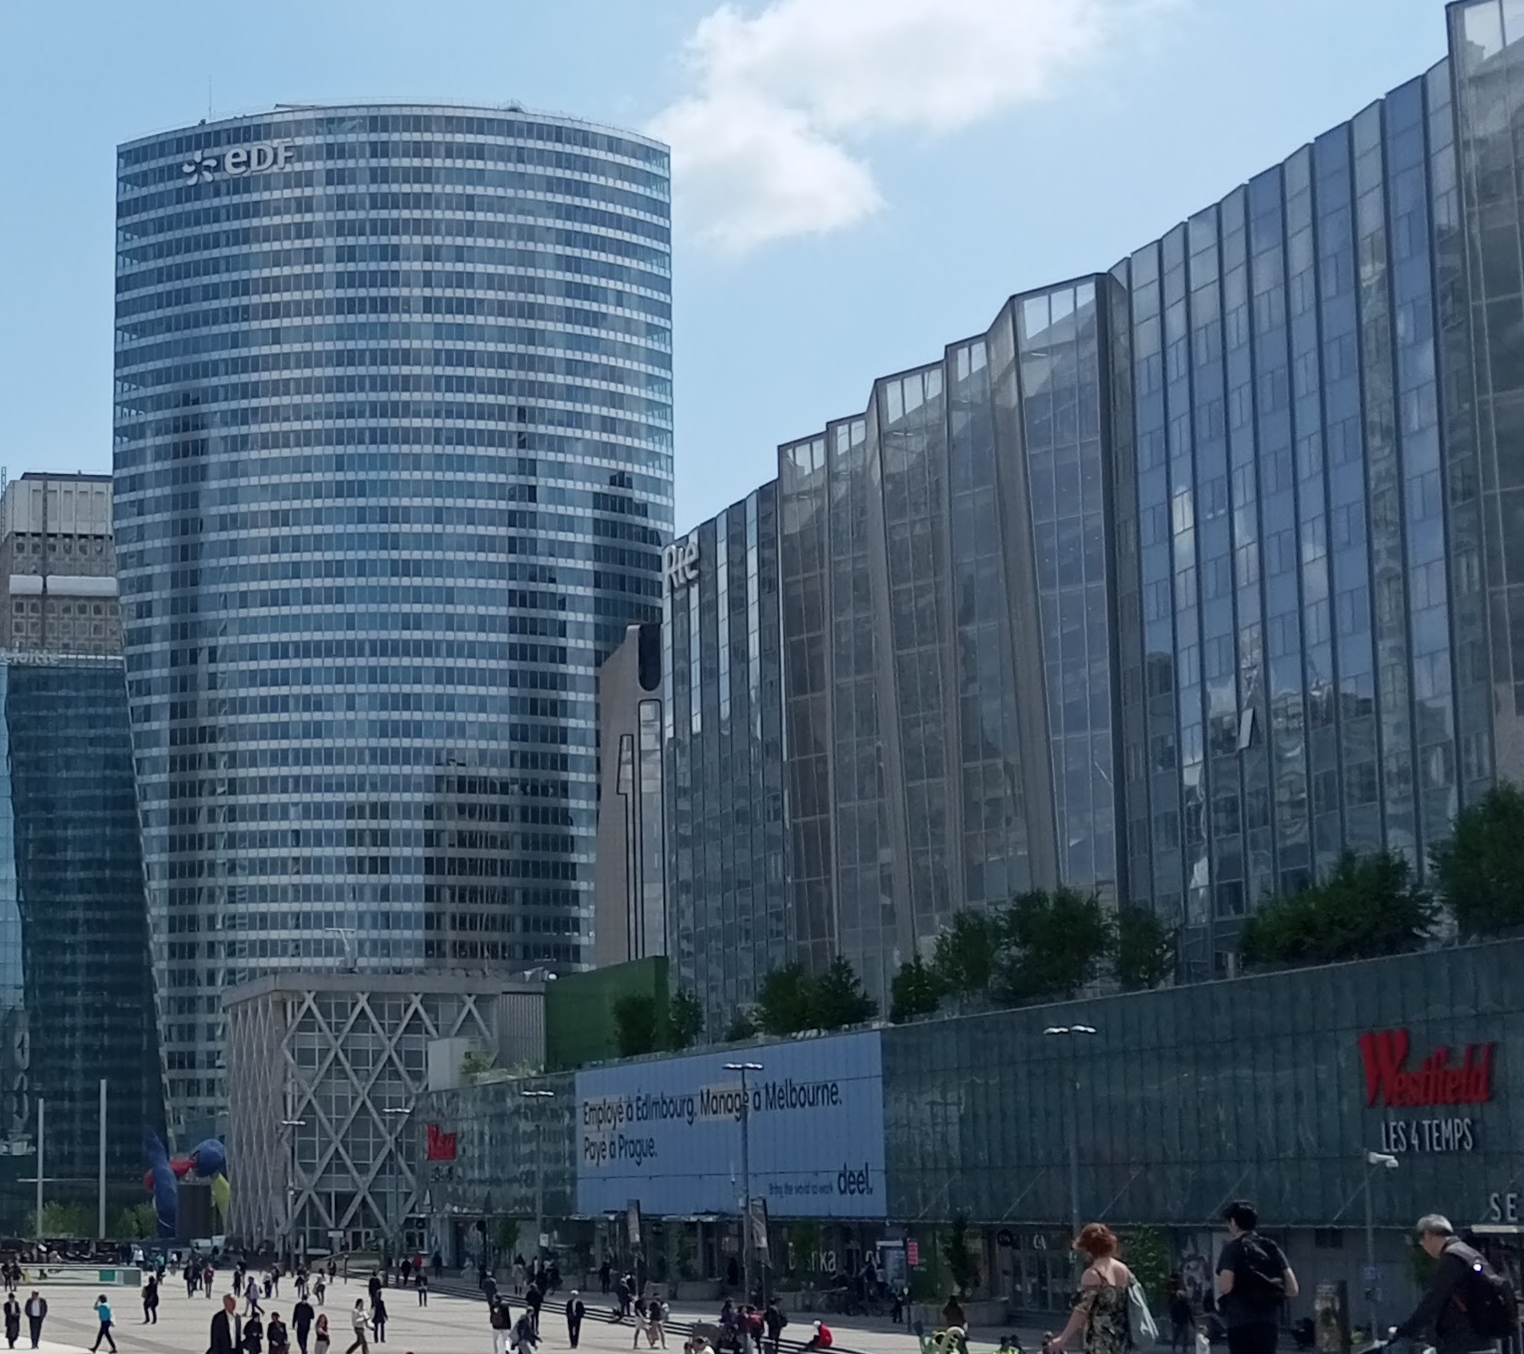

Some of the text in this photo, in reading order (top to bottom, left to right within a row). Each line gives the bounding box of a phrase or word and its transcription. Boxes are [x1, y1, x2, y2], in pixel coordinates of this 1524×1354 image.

[1358, 1028, 1493, 1108] Westfield
[583, 1096, 624, 1130] Employé
[753, 1083, 762, 1112] à
[764, 1078, 843, 1112] Melbourne.
[584, 1133, 607, 1167] Payé
[618, 1134, 658, 1166] Prague.
[1381, 1118, 1474, 1153] LES 4 TEMPS
